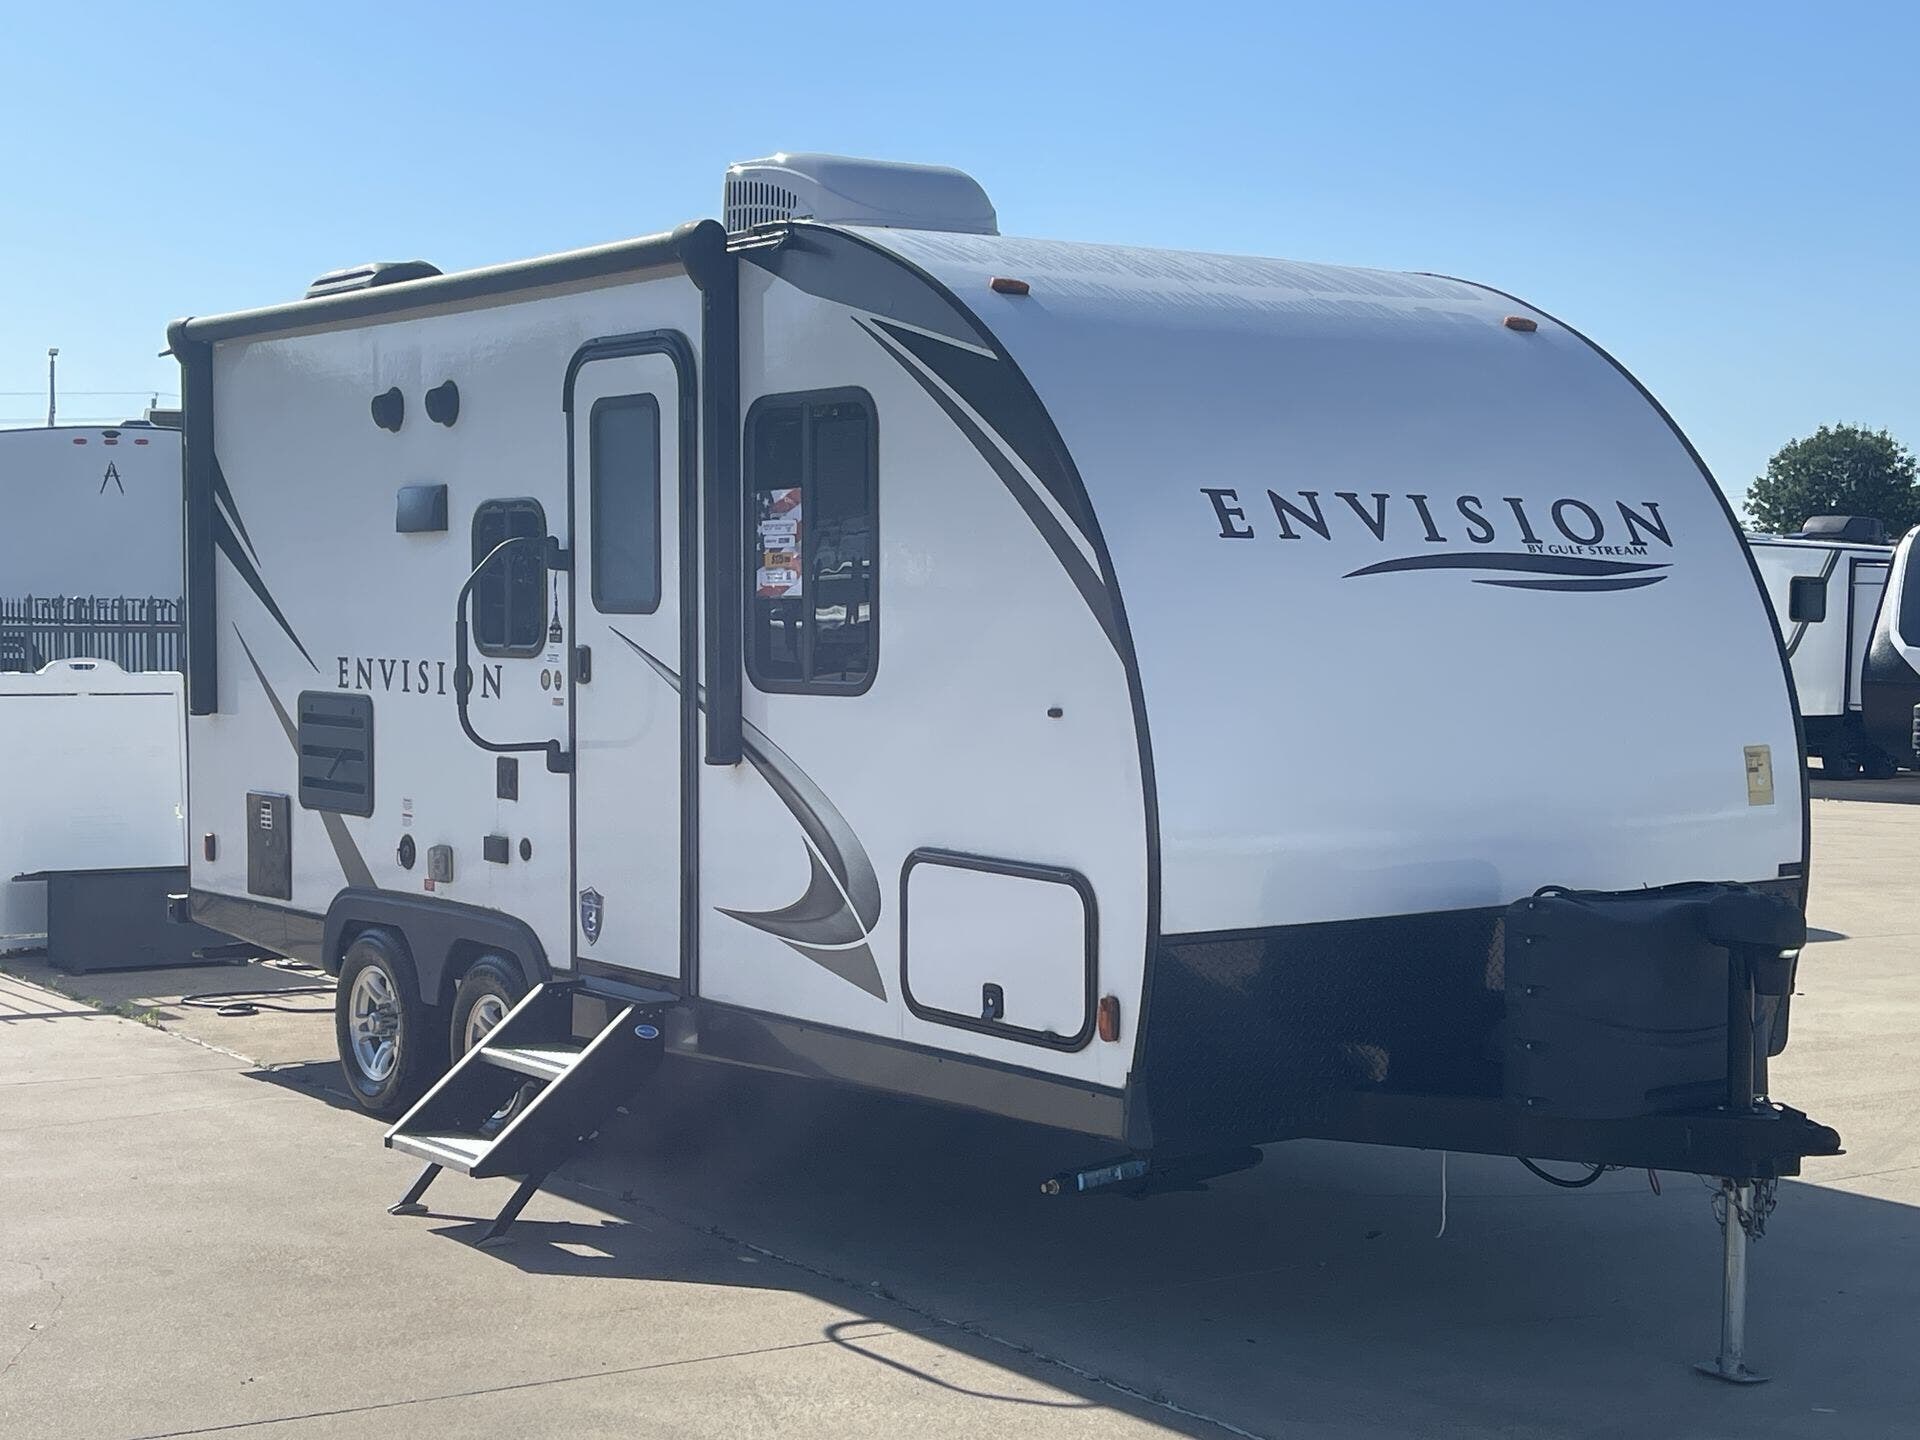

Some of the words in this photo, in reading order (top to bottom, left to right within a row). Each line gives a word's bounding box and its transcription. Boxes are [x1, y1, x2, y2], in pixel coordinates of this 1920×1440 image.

[1200, 488, 1673, 547] ENVISION
[1527, 544, 1543, 554] BY
[1548, 544, 1583, 555] GULF
[1588, 546, 1648, 556] STREAM
